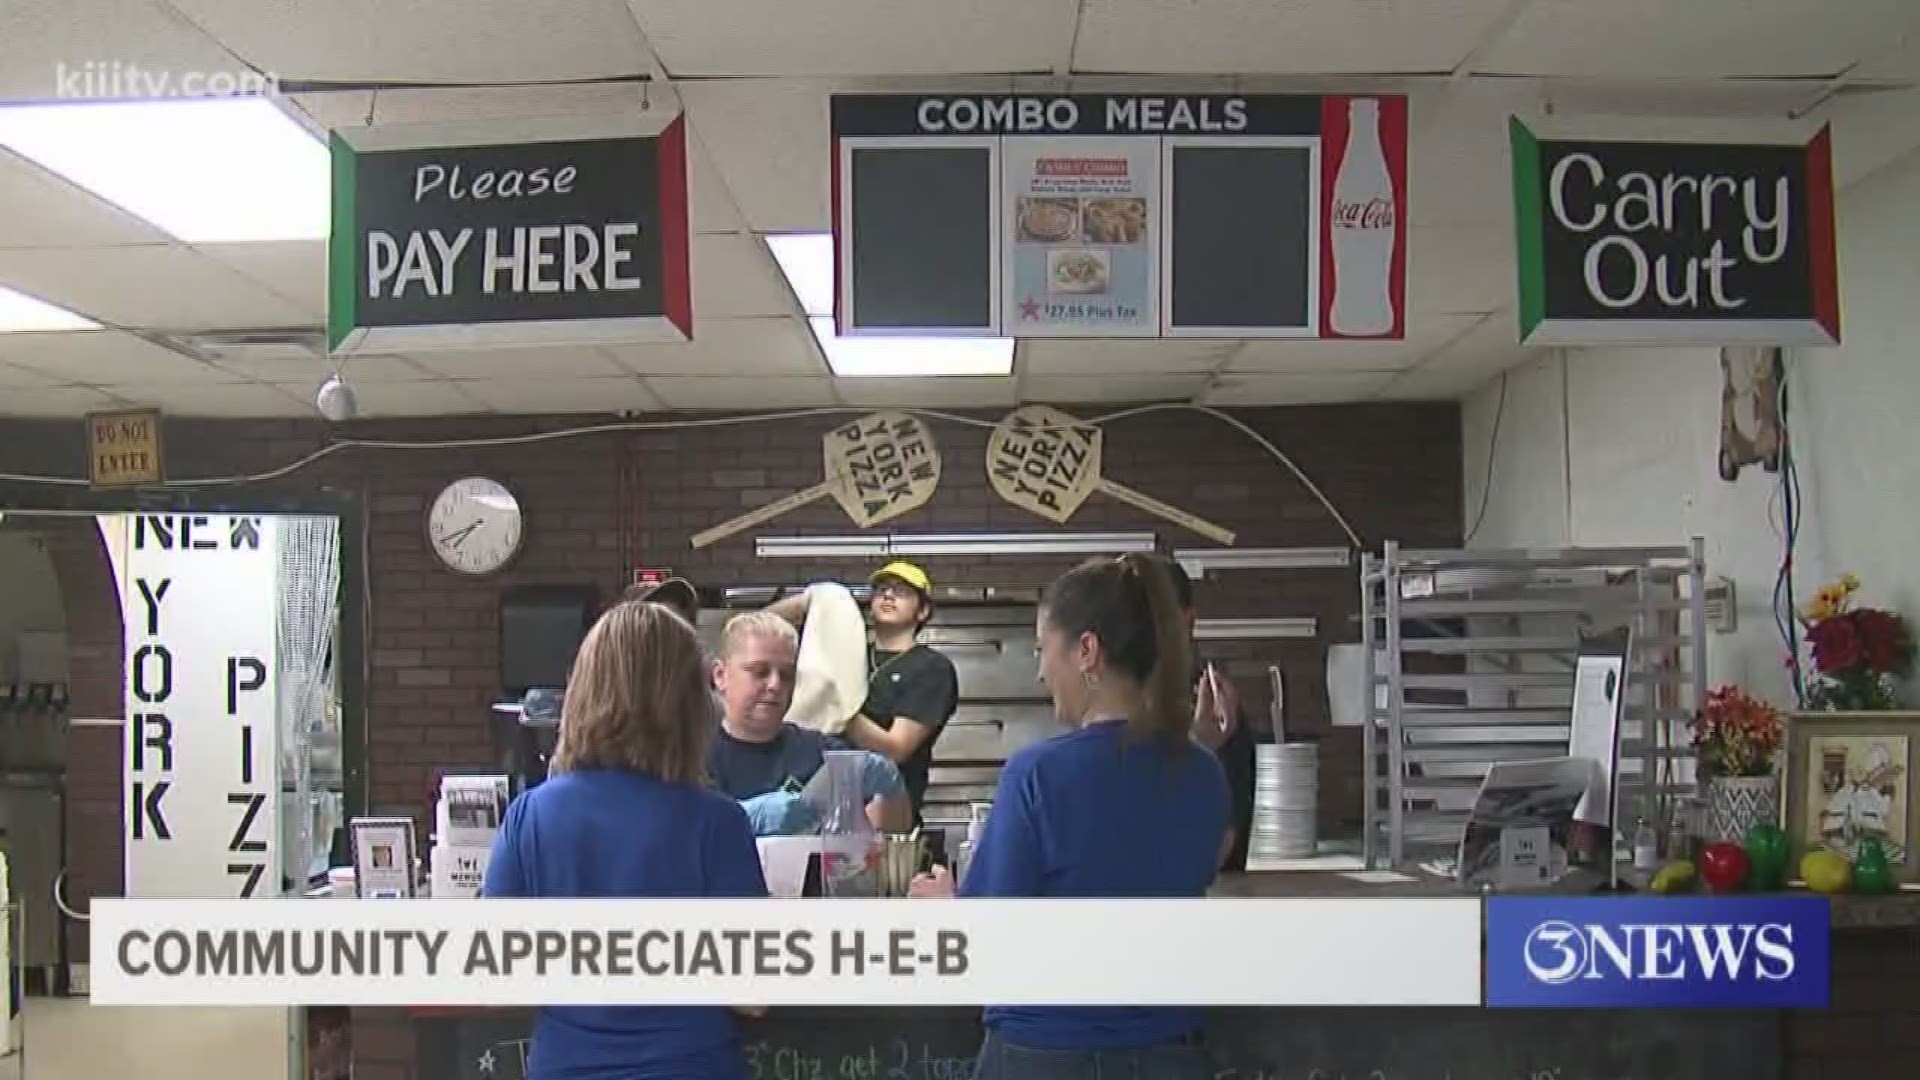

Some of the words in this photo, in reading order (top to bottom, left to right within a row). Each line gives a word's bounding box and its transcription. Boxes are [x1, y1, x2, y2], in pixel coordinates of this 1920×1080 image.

[917, 99, 1079, 131] COMBO
[1105, 98, 1247, 131] MEALS
[414, 164, 577, 202] Please
[1550, 152, 1789, 263] Carry
[368, 227, 474, 298] PAY
[483, 222, 641, 293] HERE
[1584, 235, 1747, 307] Out
[97, 425, 116, 442] DO
[120, 420, 149, 441] NOT
[100, 452, 149, 473] ENTER
[863, 420, 913, 504] YORK
[892, 418, 936, 481] NEW
[993, 415, 1033, 481] NEW
[1014, 417, 1063, 496] YORK
[836, 425, 889, 518] PIZZA
[1037, 425, 1098, 511] PIZZA
[135, 515, 262, 550] NEW
[132, 578, 173, 841] YORK
[887, 1039, 910, 1079] 2
